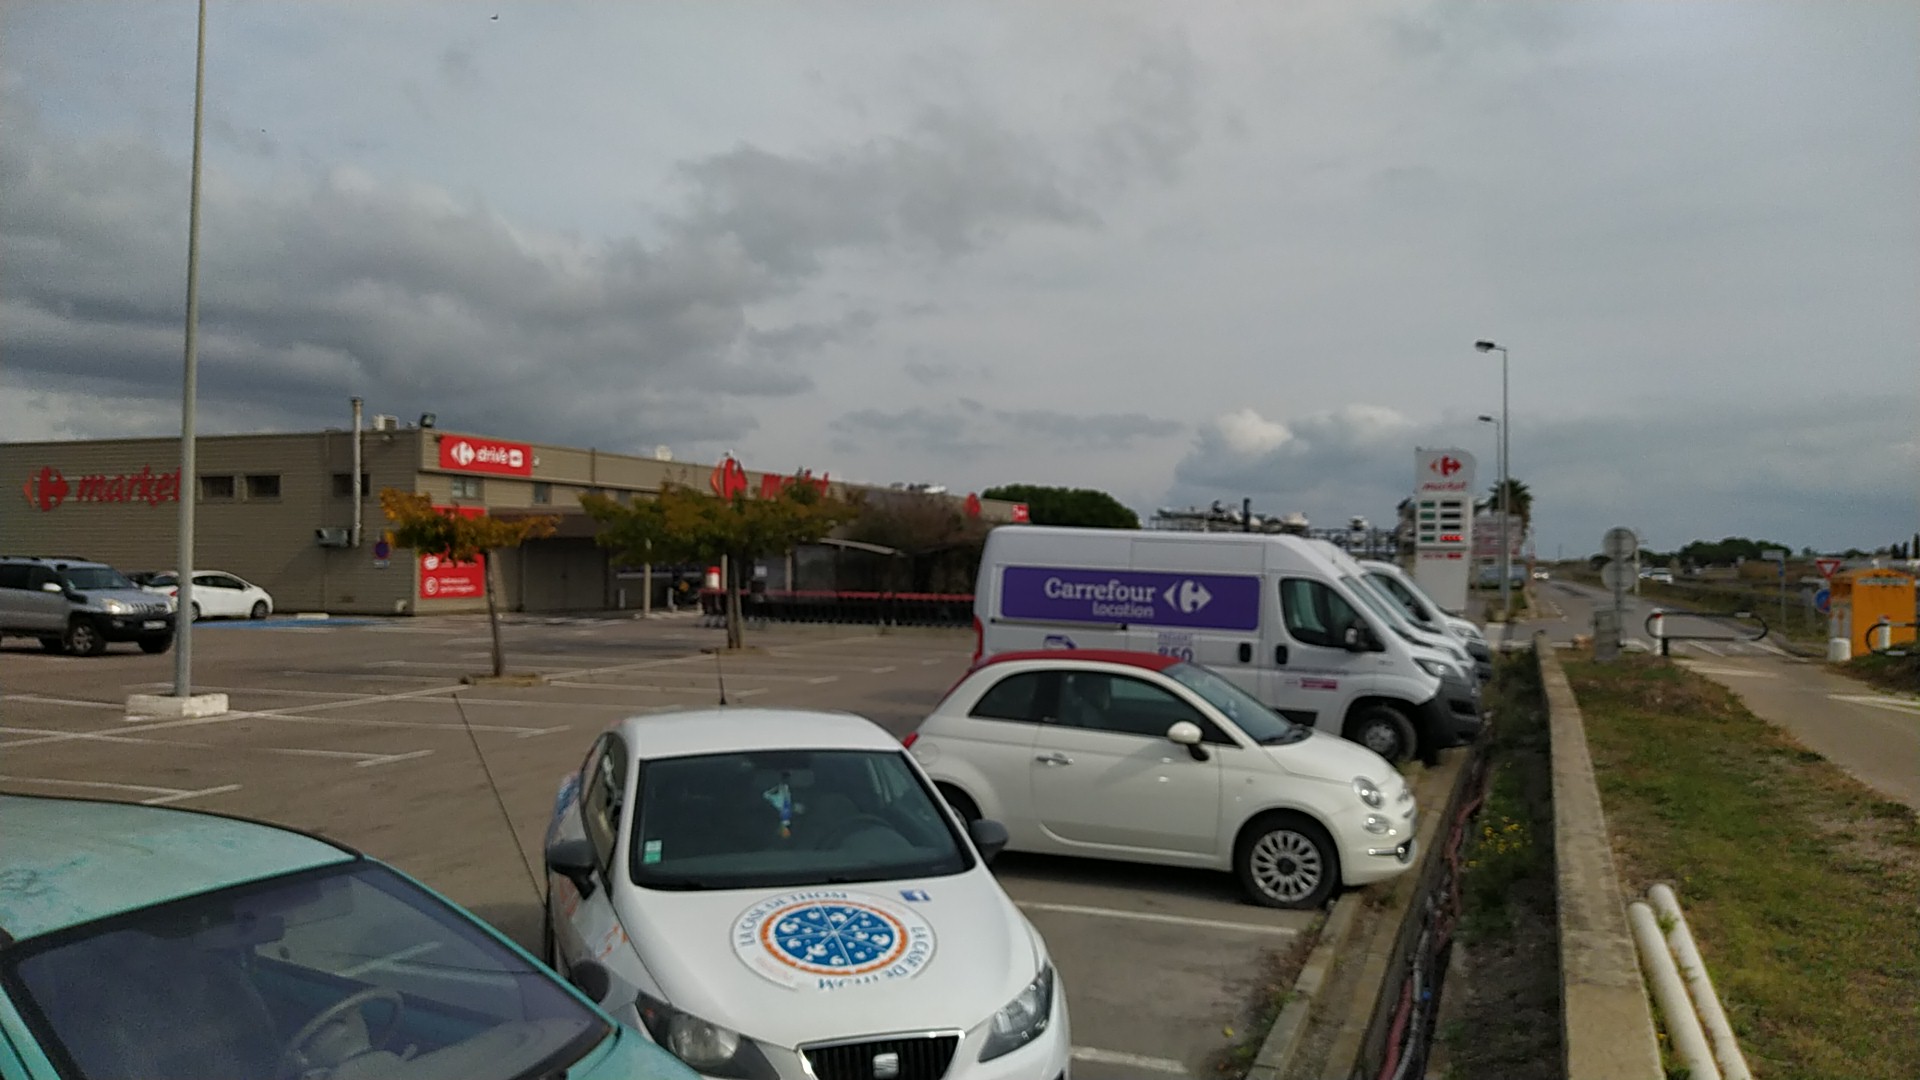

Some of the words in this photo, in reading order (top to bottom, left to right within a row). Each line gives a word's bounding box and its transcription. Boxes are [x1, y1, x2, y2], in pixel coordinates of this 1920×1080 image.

[476, 445, 509, 465] drive
[1044, 576, 1157, 602] Carrefour
[1092, 601, 1155, 618] location
